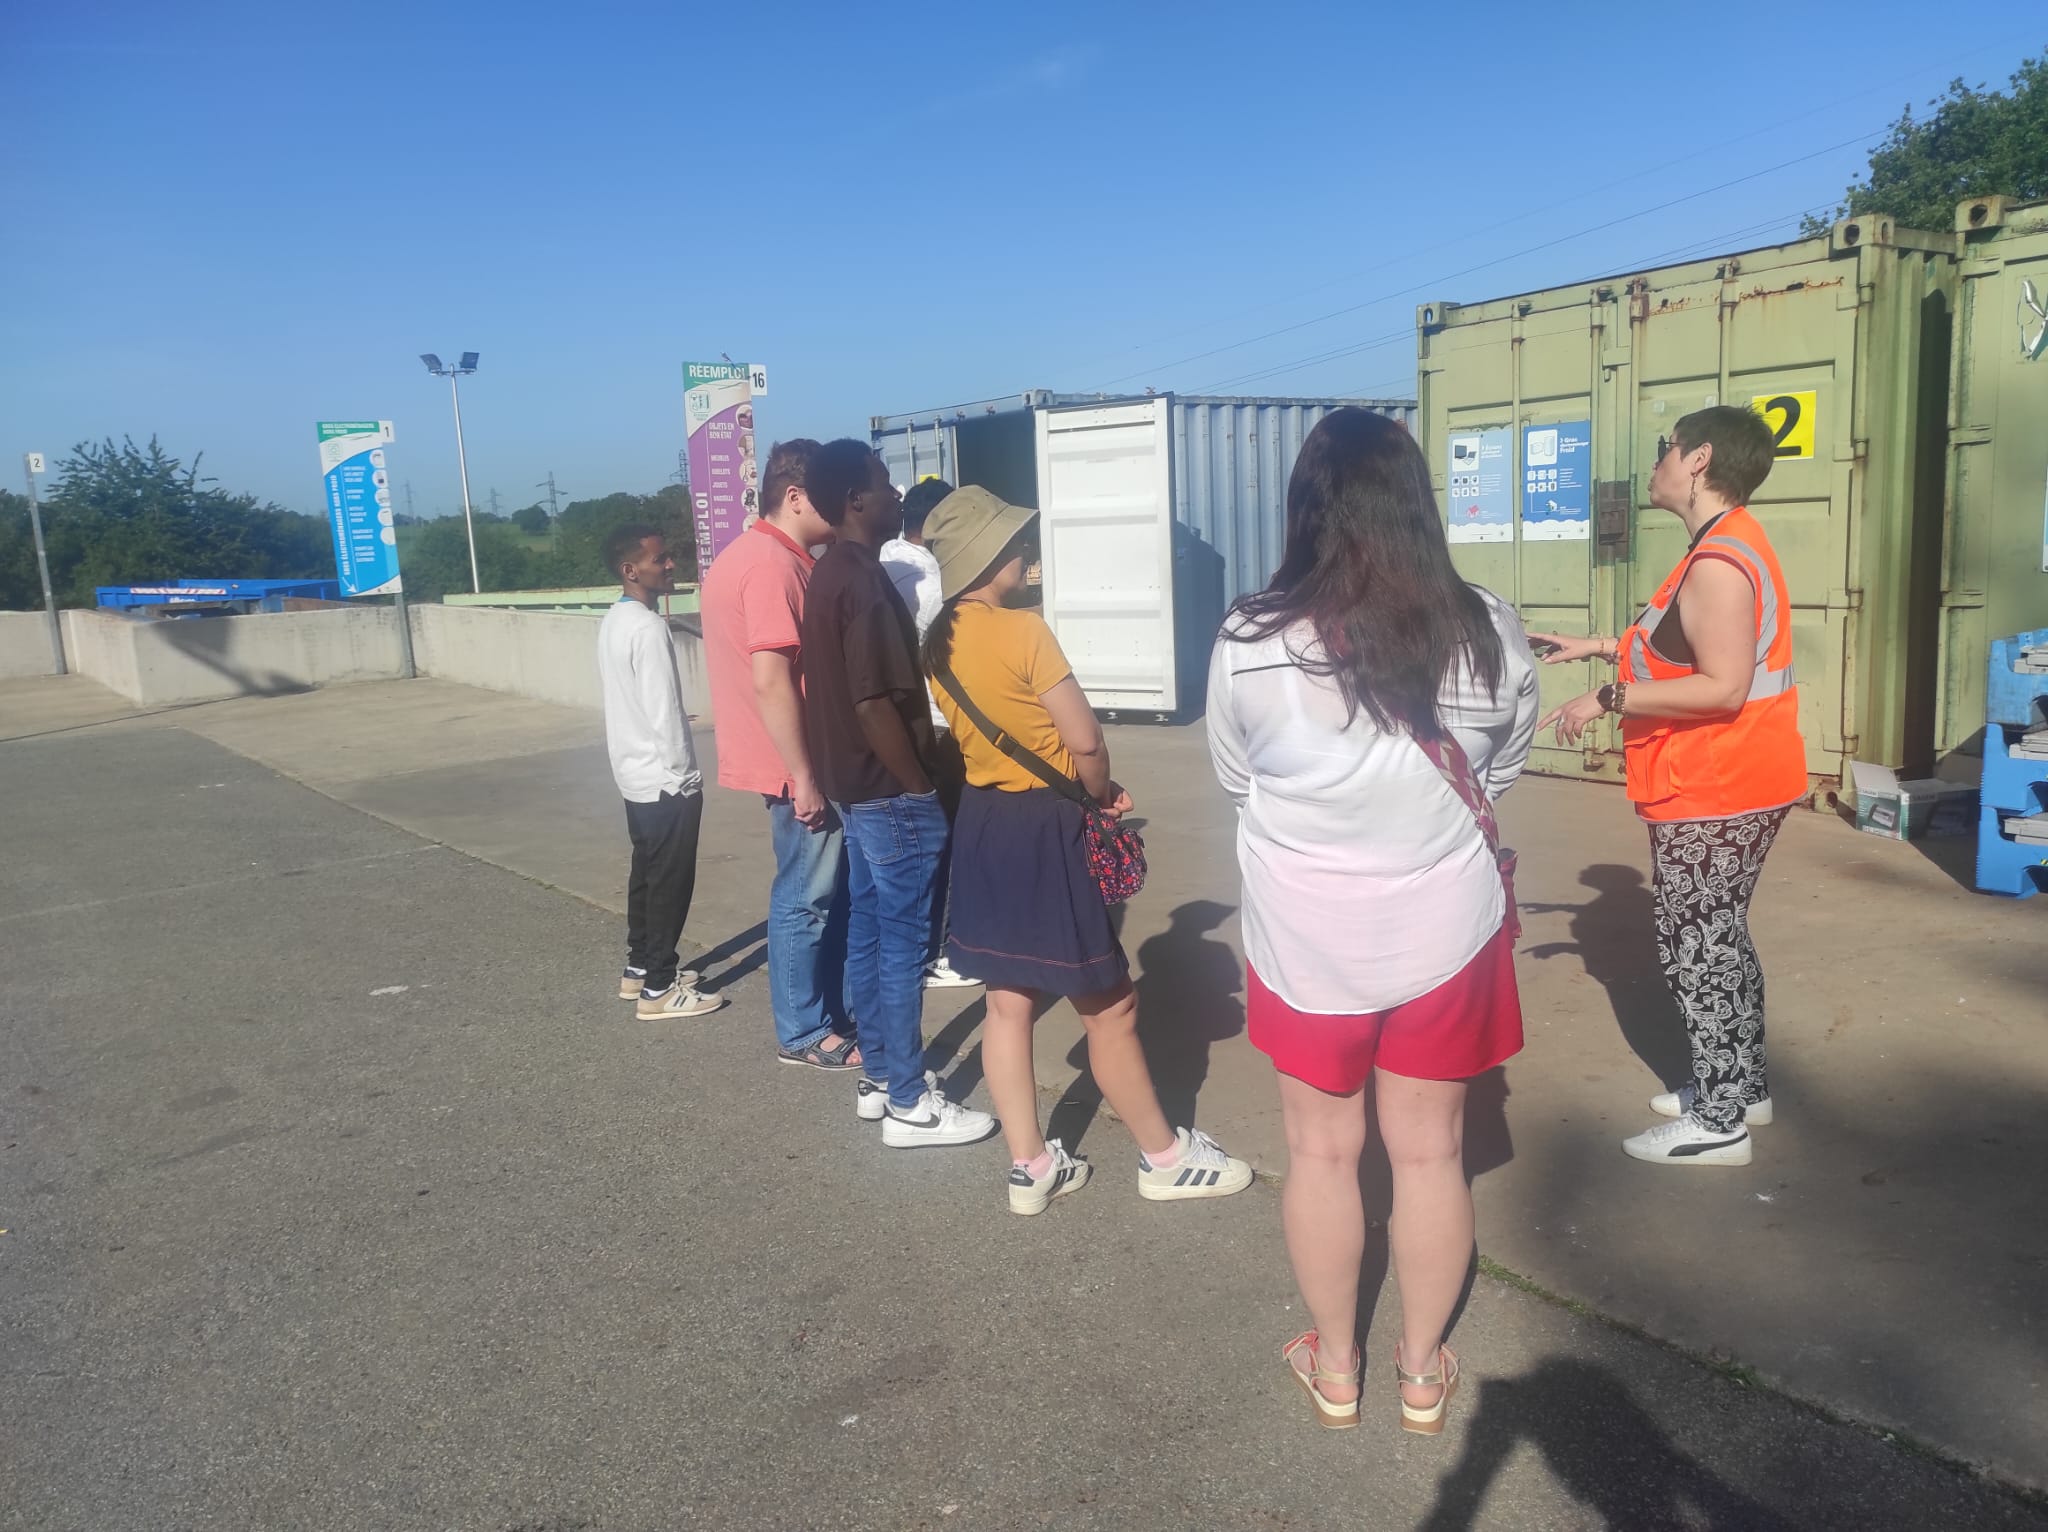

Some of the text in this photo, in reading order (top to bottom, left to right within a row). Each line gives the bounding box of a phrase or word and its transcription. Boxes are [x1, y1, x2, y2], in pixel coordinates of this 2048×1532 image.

[752, 372, 765, 388] 16
[1765, 395, 1802, 457] 2
[33, 457, 41, 468] 2
